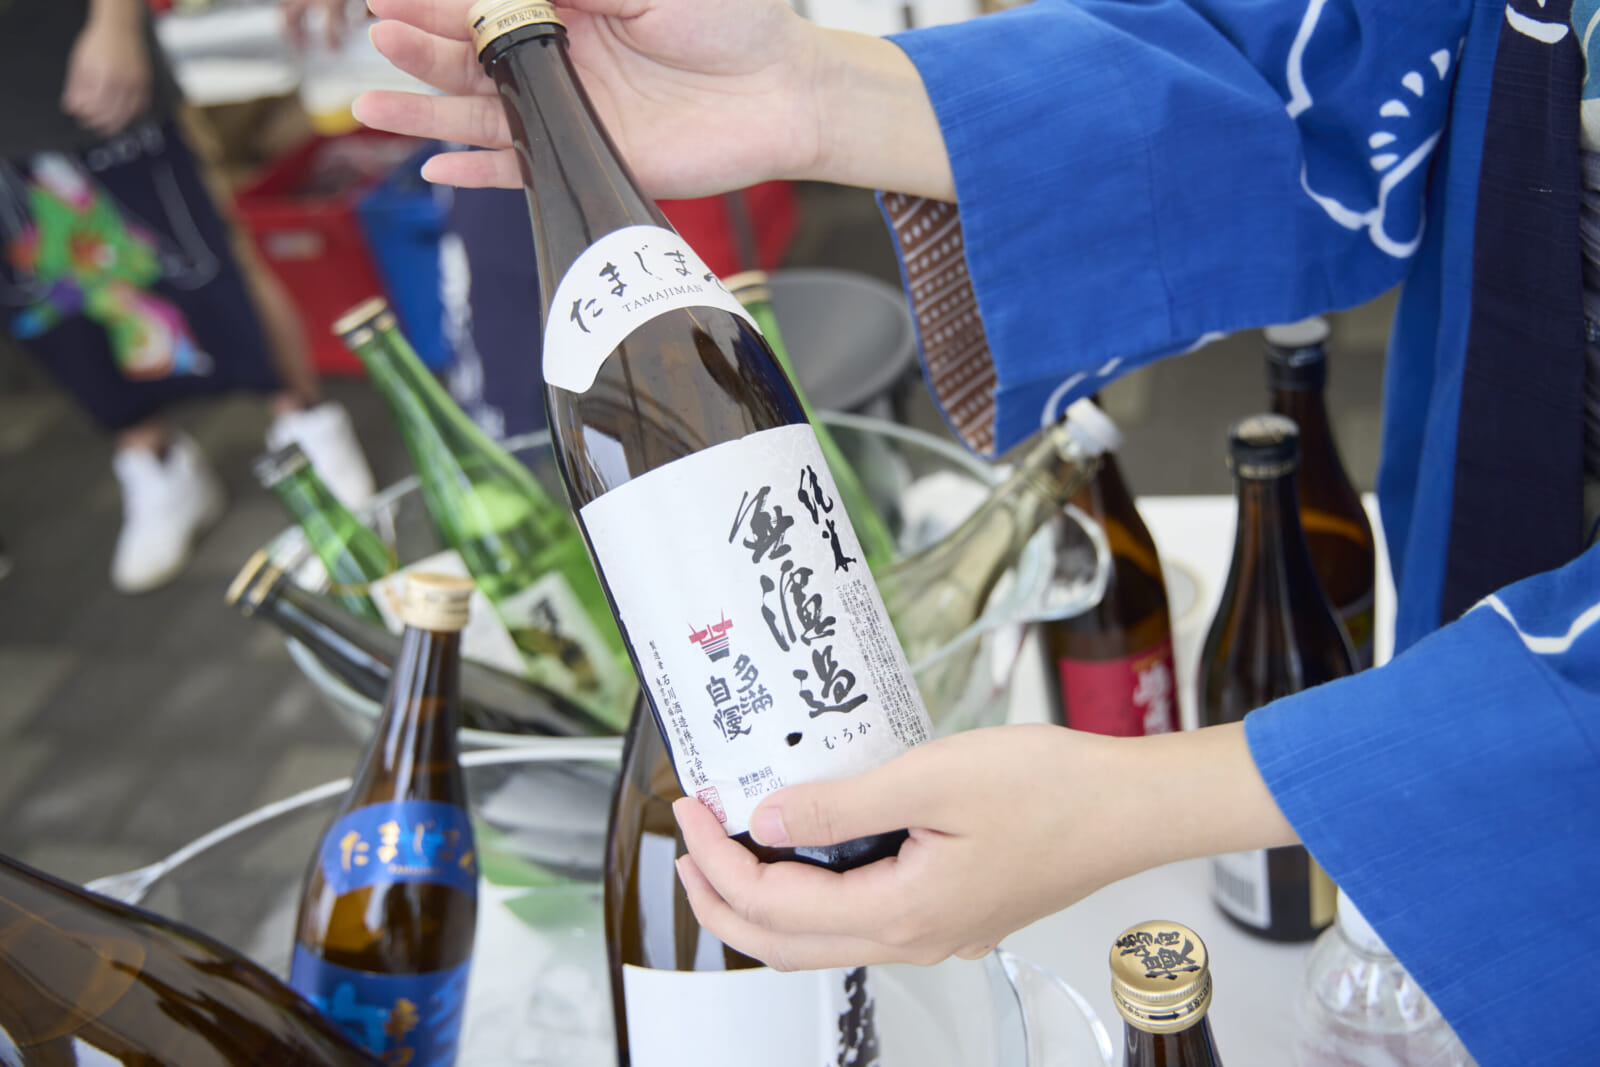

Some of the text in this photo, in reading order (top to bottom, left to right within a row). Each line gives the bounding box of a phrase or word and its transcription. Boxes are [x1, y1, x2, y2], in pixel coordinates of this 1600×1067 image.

[622, 283, 704, 313] TAMAJIMAN
[661, 674, 709, 785] 石川酒造株式会社
[823, 720, 872, 751] むろか
[743, 776, 785, 799] R07.01
